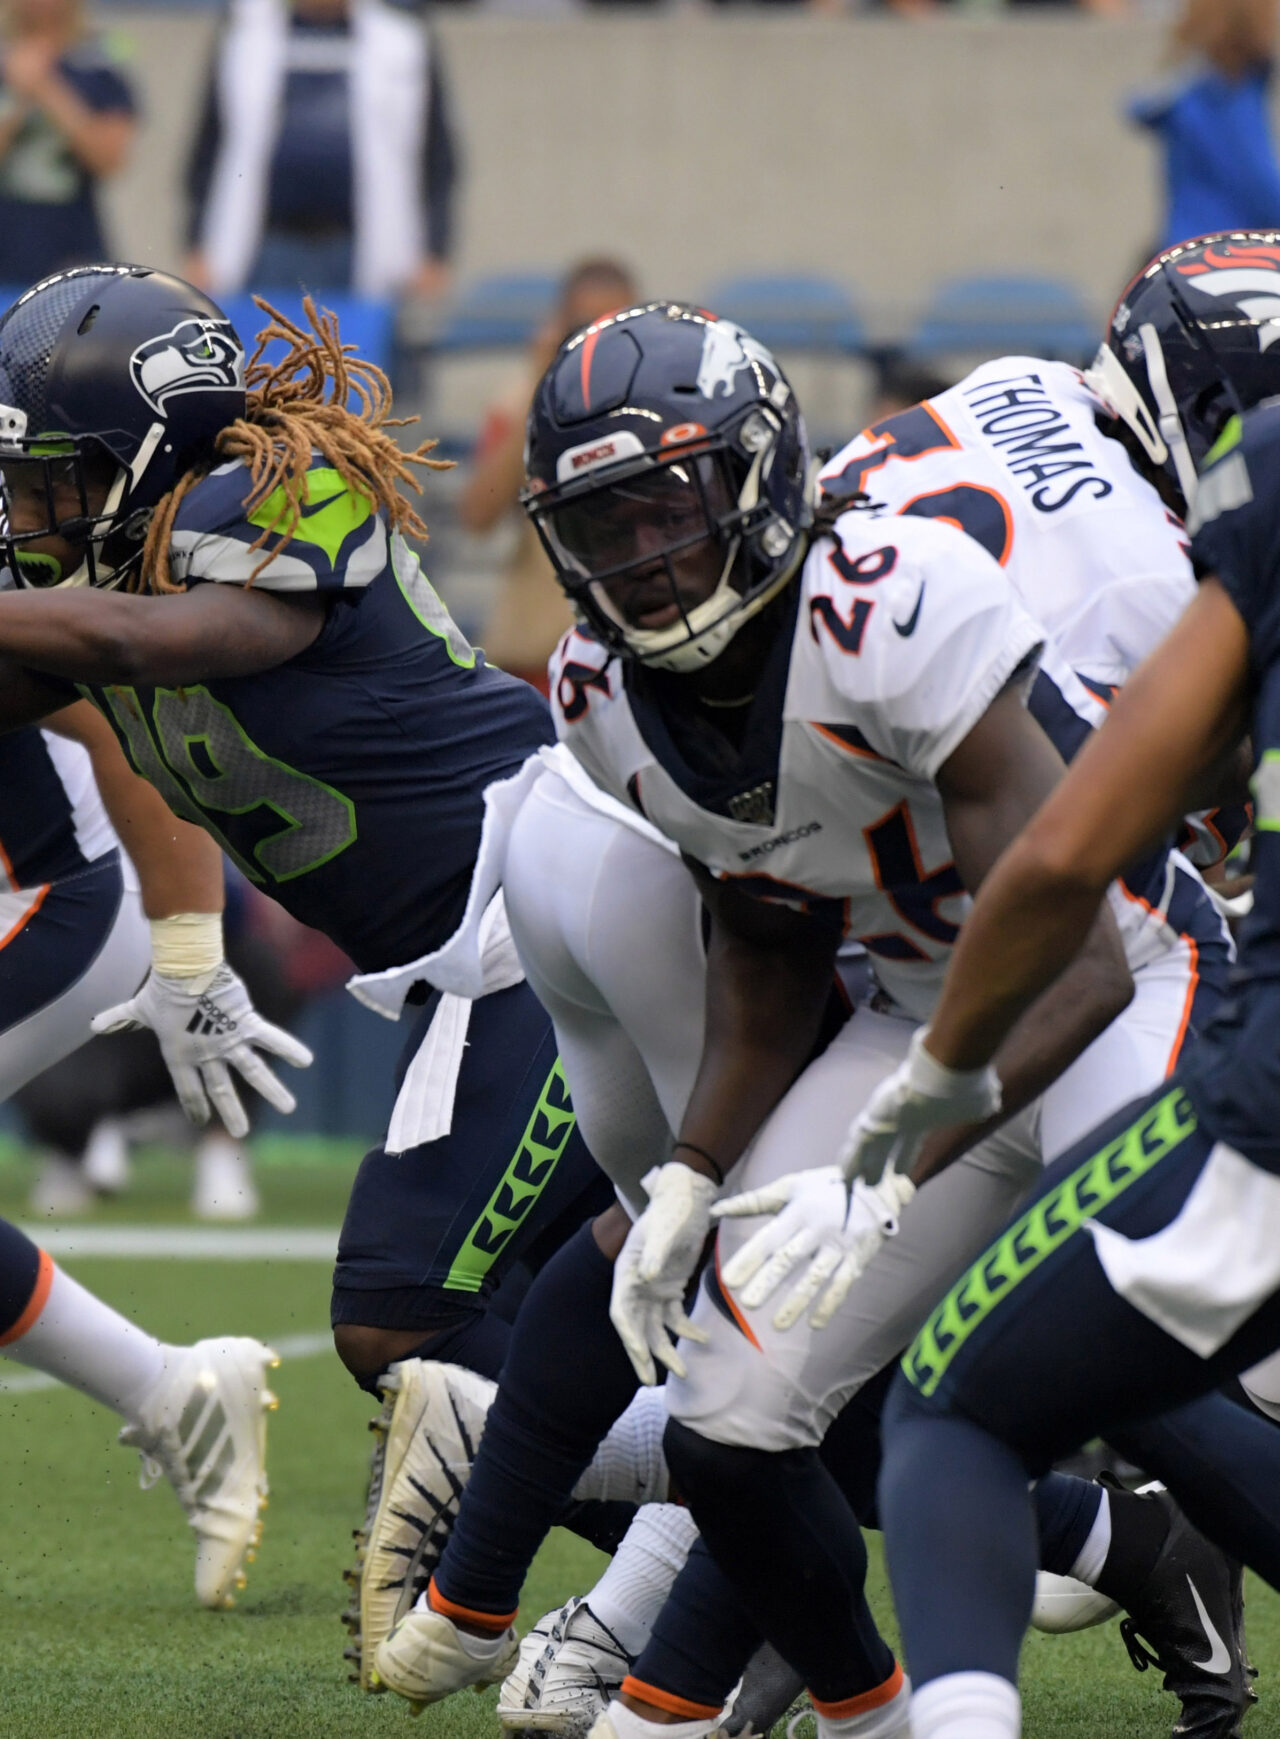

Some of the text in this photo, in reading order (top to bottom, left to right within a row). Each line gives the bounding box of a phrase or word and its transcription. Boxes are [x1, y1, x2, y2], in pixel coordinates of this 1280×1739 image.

[962, 374, 1113, 513] THOMAS
[808, 544, 898, 656] 26
[738, 821, 823, 863] BRONCOS
